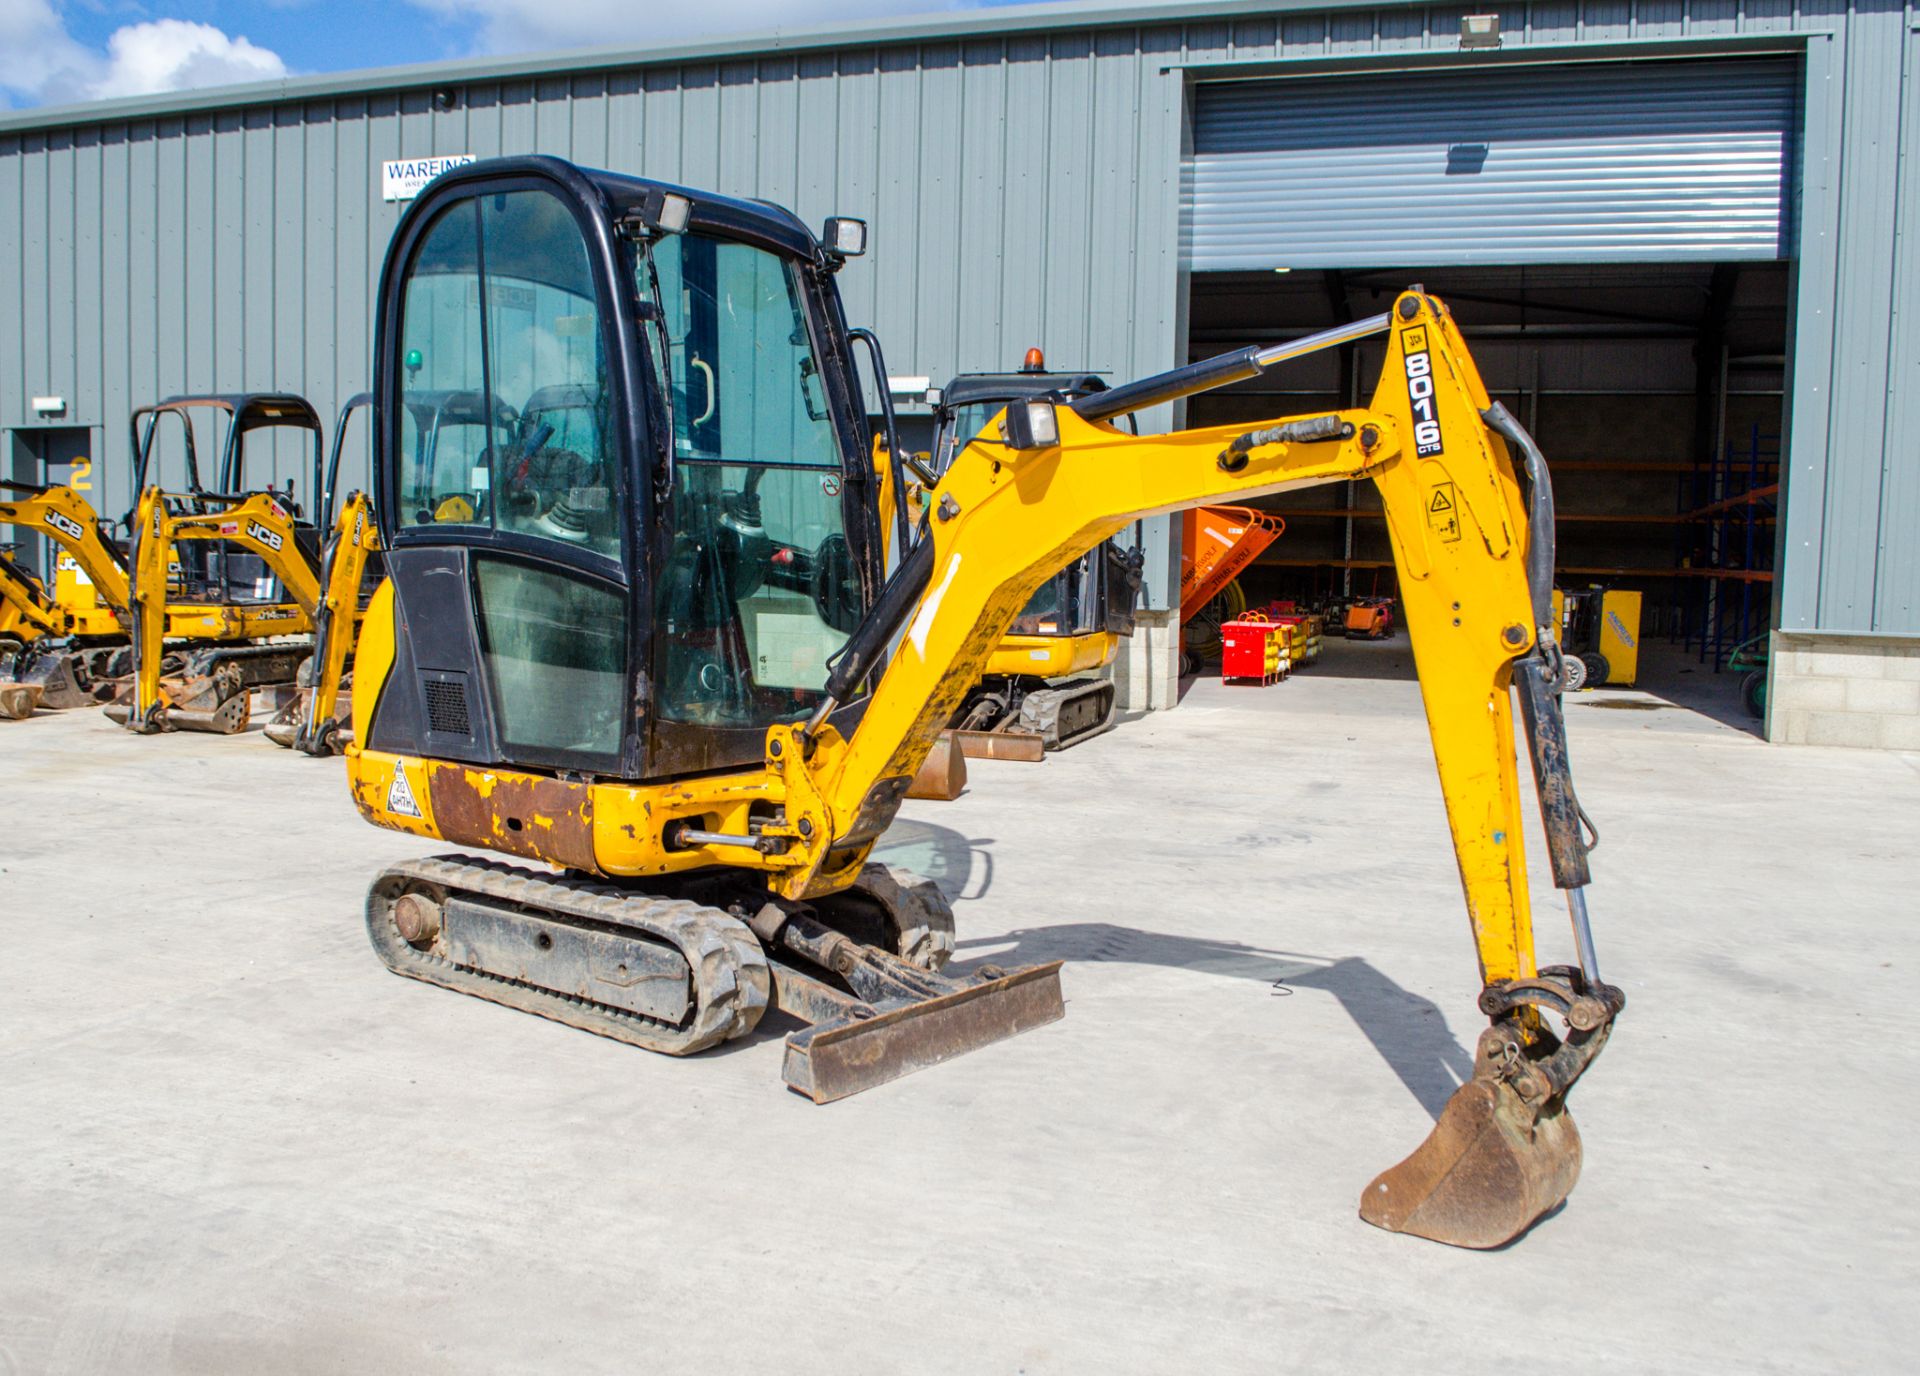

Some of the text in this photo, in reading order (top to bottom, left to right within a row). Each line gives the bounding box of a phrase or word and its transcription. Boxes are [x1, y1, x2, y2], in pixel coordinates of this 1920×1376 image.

[1406, 352, 1440, 446] 8016
[1418, 442, 1441, 454] CTS
[70, 456, 92, 490] 2
[45, 511, 82, 540] JCB
[247, 523, 282, 551] JCB
